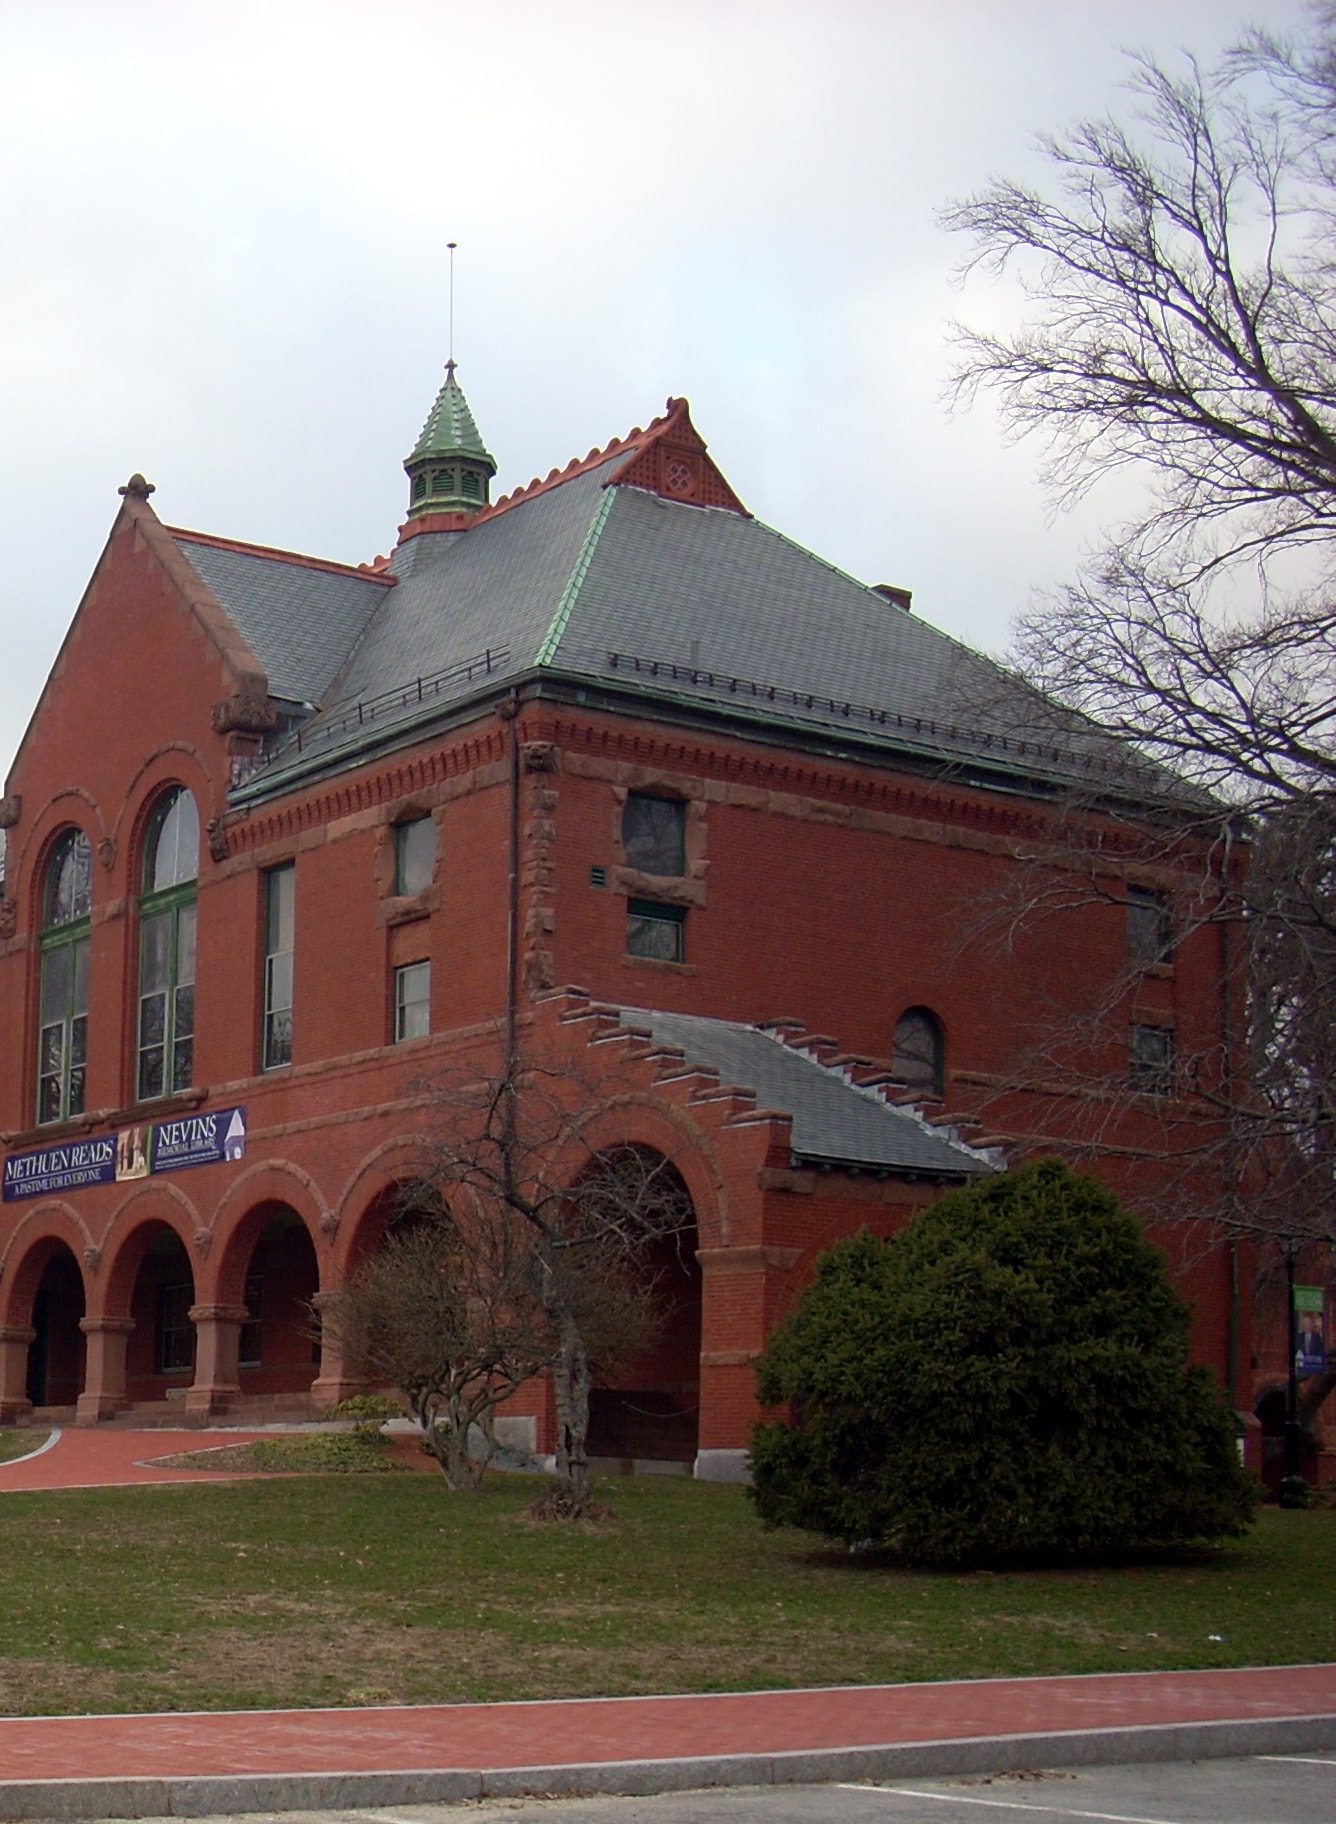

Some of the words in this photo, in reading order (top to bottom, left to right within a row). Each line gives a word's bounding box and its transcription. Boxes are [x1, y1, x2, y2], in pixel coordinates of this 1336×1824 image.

[157, 1115, 217, 1147] NEVINS
[5, 1149, 70, 1180] METHUEN
[71, 1140, 114, 1168] READS
[14, 1184, 20, 1195] A
[20, 1179, 49, 1194] PASTIME
[49, 1175, 63, 1190] FOR
[64, 1168, 102, 1188] EVERYONE
